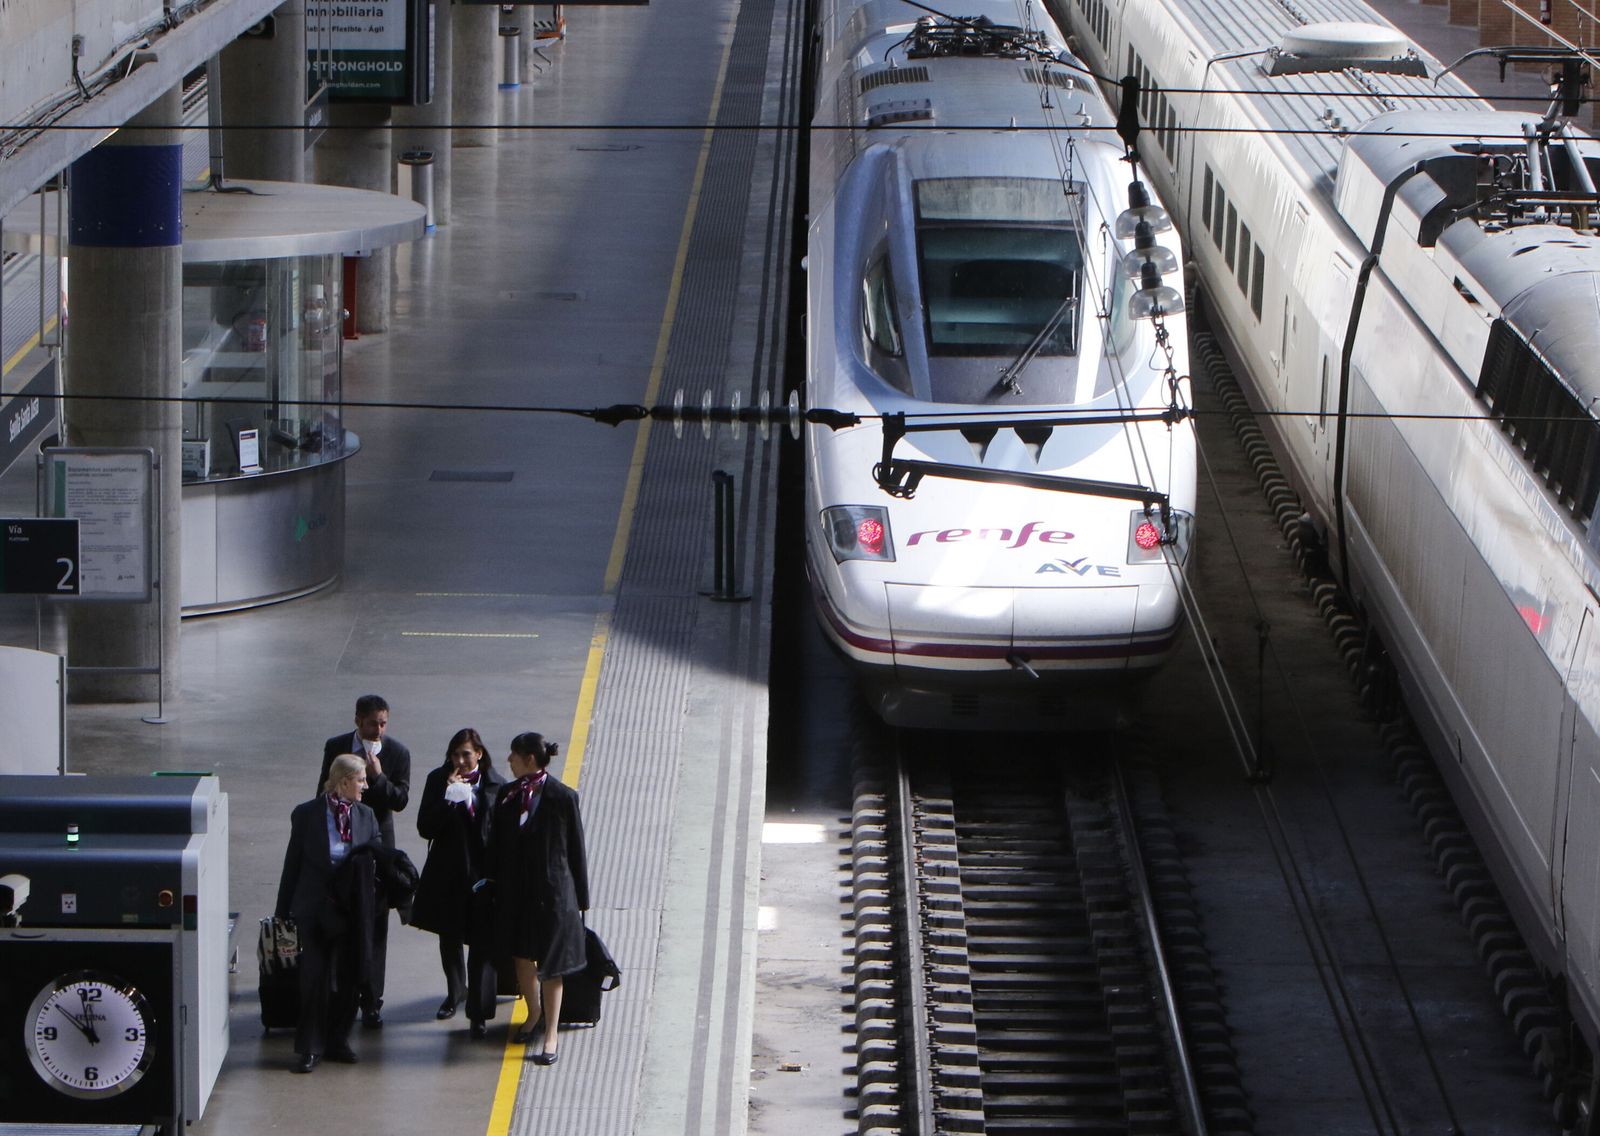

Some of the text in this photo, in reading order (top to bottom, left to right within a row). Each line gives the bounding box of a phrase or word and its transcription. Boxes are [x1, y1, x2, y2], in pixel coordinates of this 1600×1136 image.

[305, 6, 383, 17] nmobiliaria
[312, 61, 403, 72] STRONGHOLD
[906, 521, 1075, 549] renfe
[56, 557, 74, 590] 2
[1035, 558, 1121, 577] AVE
[79, 988, 102, 1002] 12
[43, 1026, 58, 1041] 9
[125, 1027, 139, 1042] 3
[84, 1066, 98, 1081] 6
